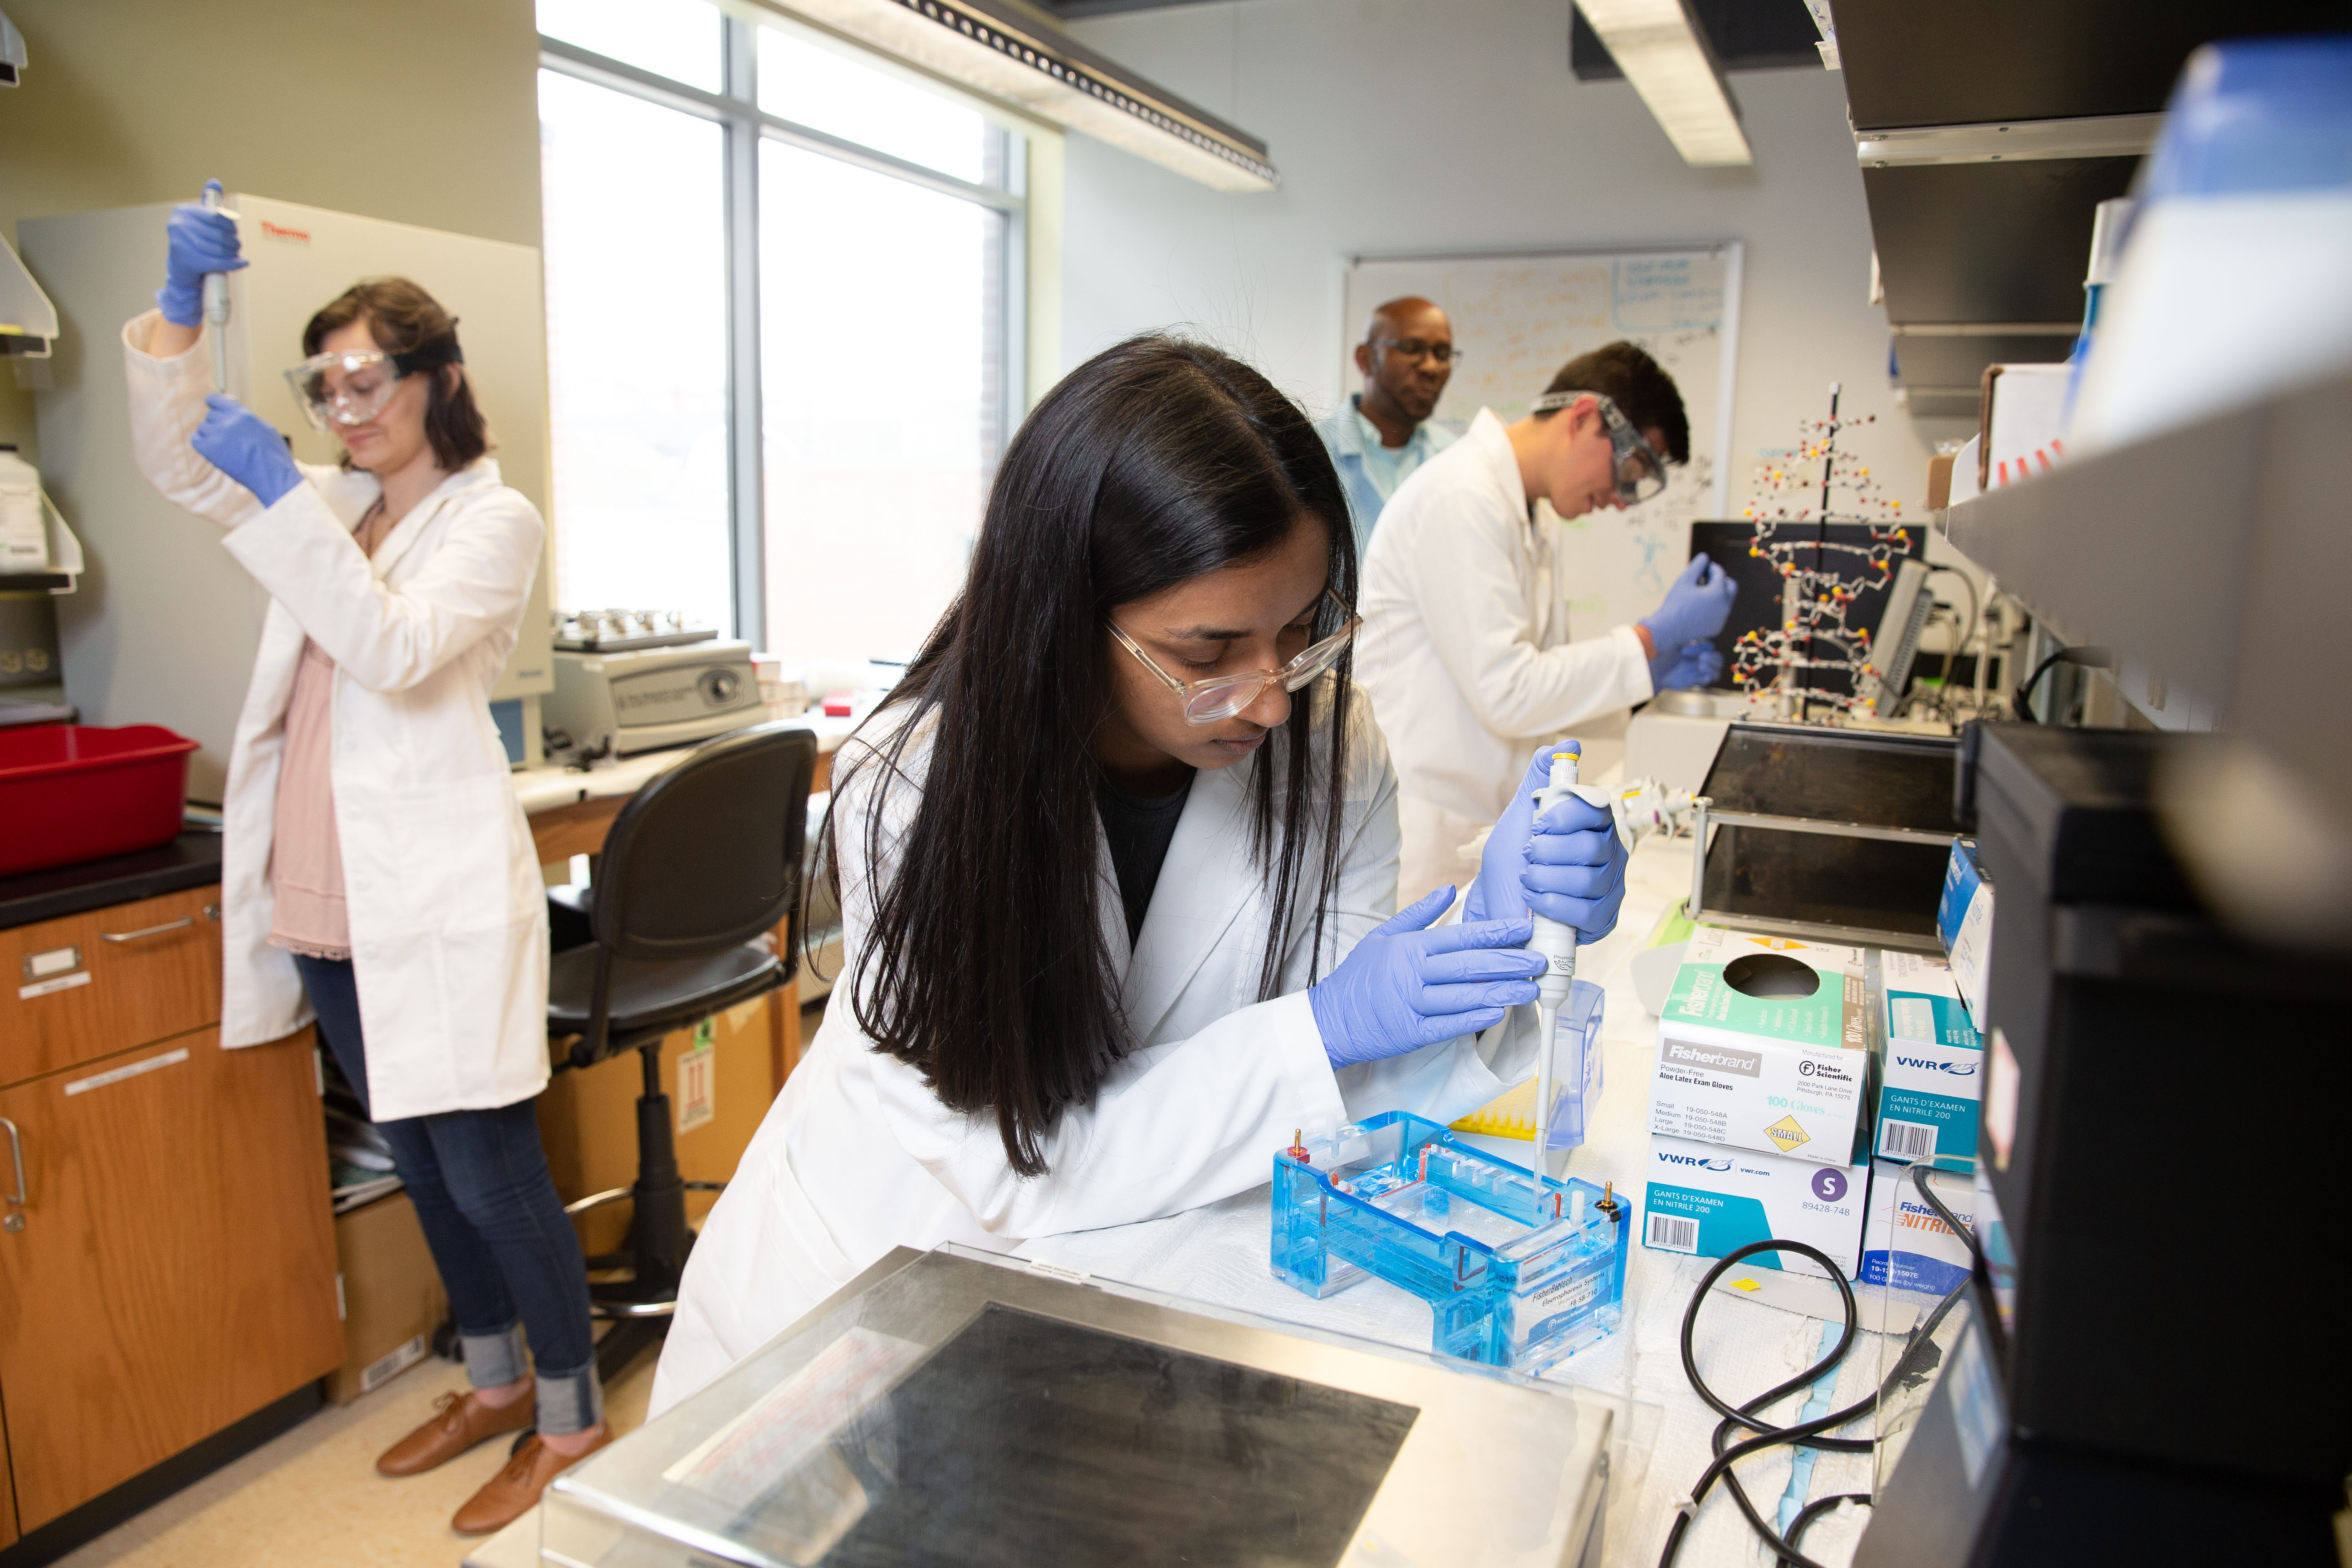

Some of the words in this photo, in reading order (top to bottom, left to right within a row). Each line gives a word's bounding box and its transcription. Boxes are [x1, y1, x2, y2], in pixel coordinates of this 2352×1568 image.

[1678, 969, 1715, 1017] Fisherbrand
[1845, 1031, 1862, 1043] 100
[1669, 1044, 1755, 1070] Fisherbrand
[1802, 1049, 1836, 1060] Manufactured
[1896, 1056, 1938, 1070] VWR
[1661, 1064, 1705, 1078] Powder-Free
[1816, 1071, 1852, 1082] Scientific
[1817, 1064, 1842, 1073] Fisher
[1659, 1072, 1673, 1080] Aloe
[1675, 1075, 1692, 1083] Latex
[1694, 1078, 1710, 1087] Exam
[1712, 1081, 1733, 1090] Gloves
[1797, 1087, 1823, 1096] Pittsburgh,
[1656, 1101, 1675, 1109] Small
[1686, 1106, 1727, 1119] 19-050-548A
[1767, 1095, 1788, 1107] 100
[1791, 1099, 1825, 1115] Gloves
[1891, 1095, 1919, 1105] GANTS
[1921, 1099, 1966, 1112] D'EXAMEN
[1656, 1109, 1681, 1118] Medium
[1685, 1114, 1727, 1127] 19-050-548B
[1903, 1106, 1932, 1117] NITRILE
[1935, 1111, 1950, 1119] 200
[1654, 1124, 1680, 1133] X-Large
[1684, 1130, 1725, 1142] 19-050-548D
[1655, 1117, 1673, 1125] Large
[1684, 1122, 1726, 1134] 19-050-548C
[1770, 1127, 1803, 1142] SMALL
[1658, 1152, 1696, 1166] VWR
[1740, 1167, 1770, 1176] vwr.com
[1823, 1177, 1835, 1195] S
[1654, 1190, 1680, 1200] GANTS
[1682, 1194, 1724, 1207] D'EXAMEN
[1666, 1200, 1693, 1211] NITRILE
[1802, 1202, 1850, 1215] 89428-748
[1900, 1201, 1974, 1222] Fisheand
[1533, 1276, 1573, 1302] FisherBiotech
[1542, 1283, 1583, 1307] Electrophoresis
[1584, 1272, 1605, 1286] Systems
[1914, 1282, 1935, 1291] weight)
[1570, 1288, 1597, 1307] FB-SB-710
